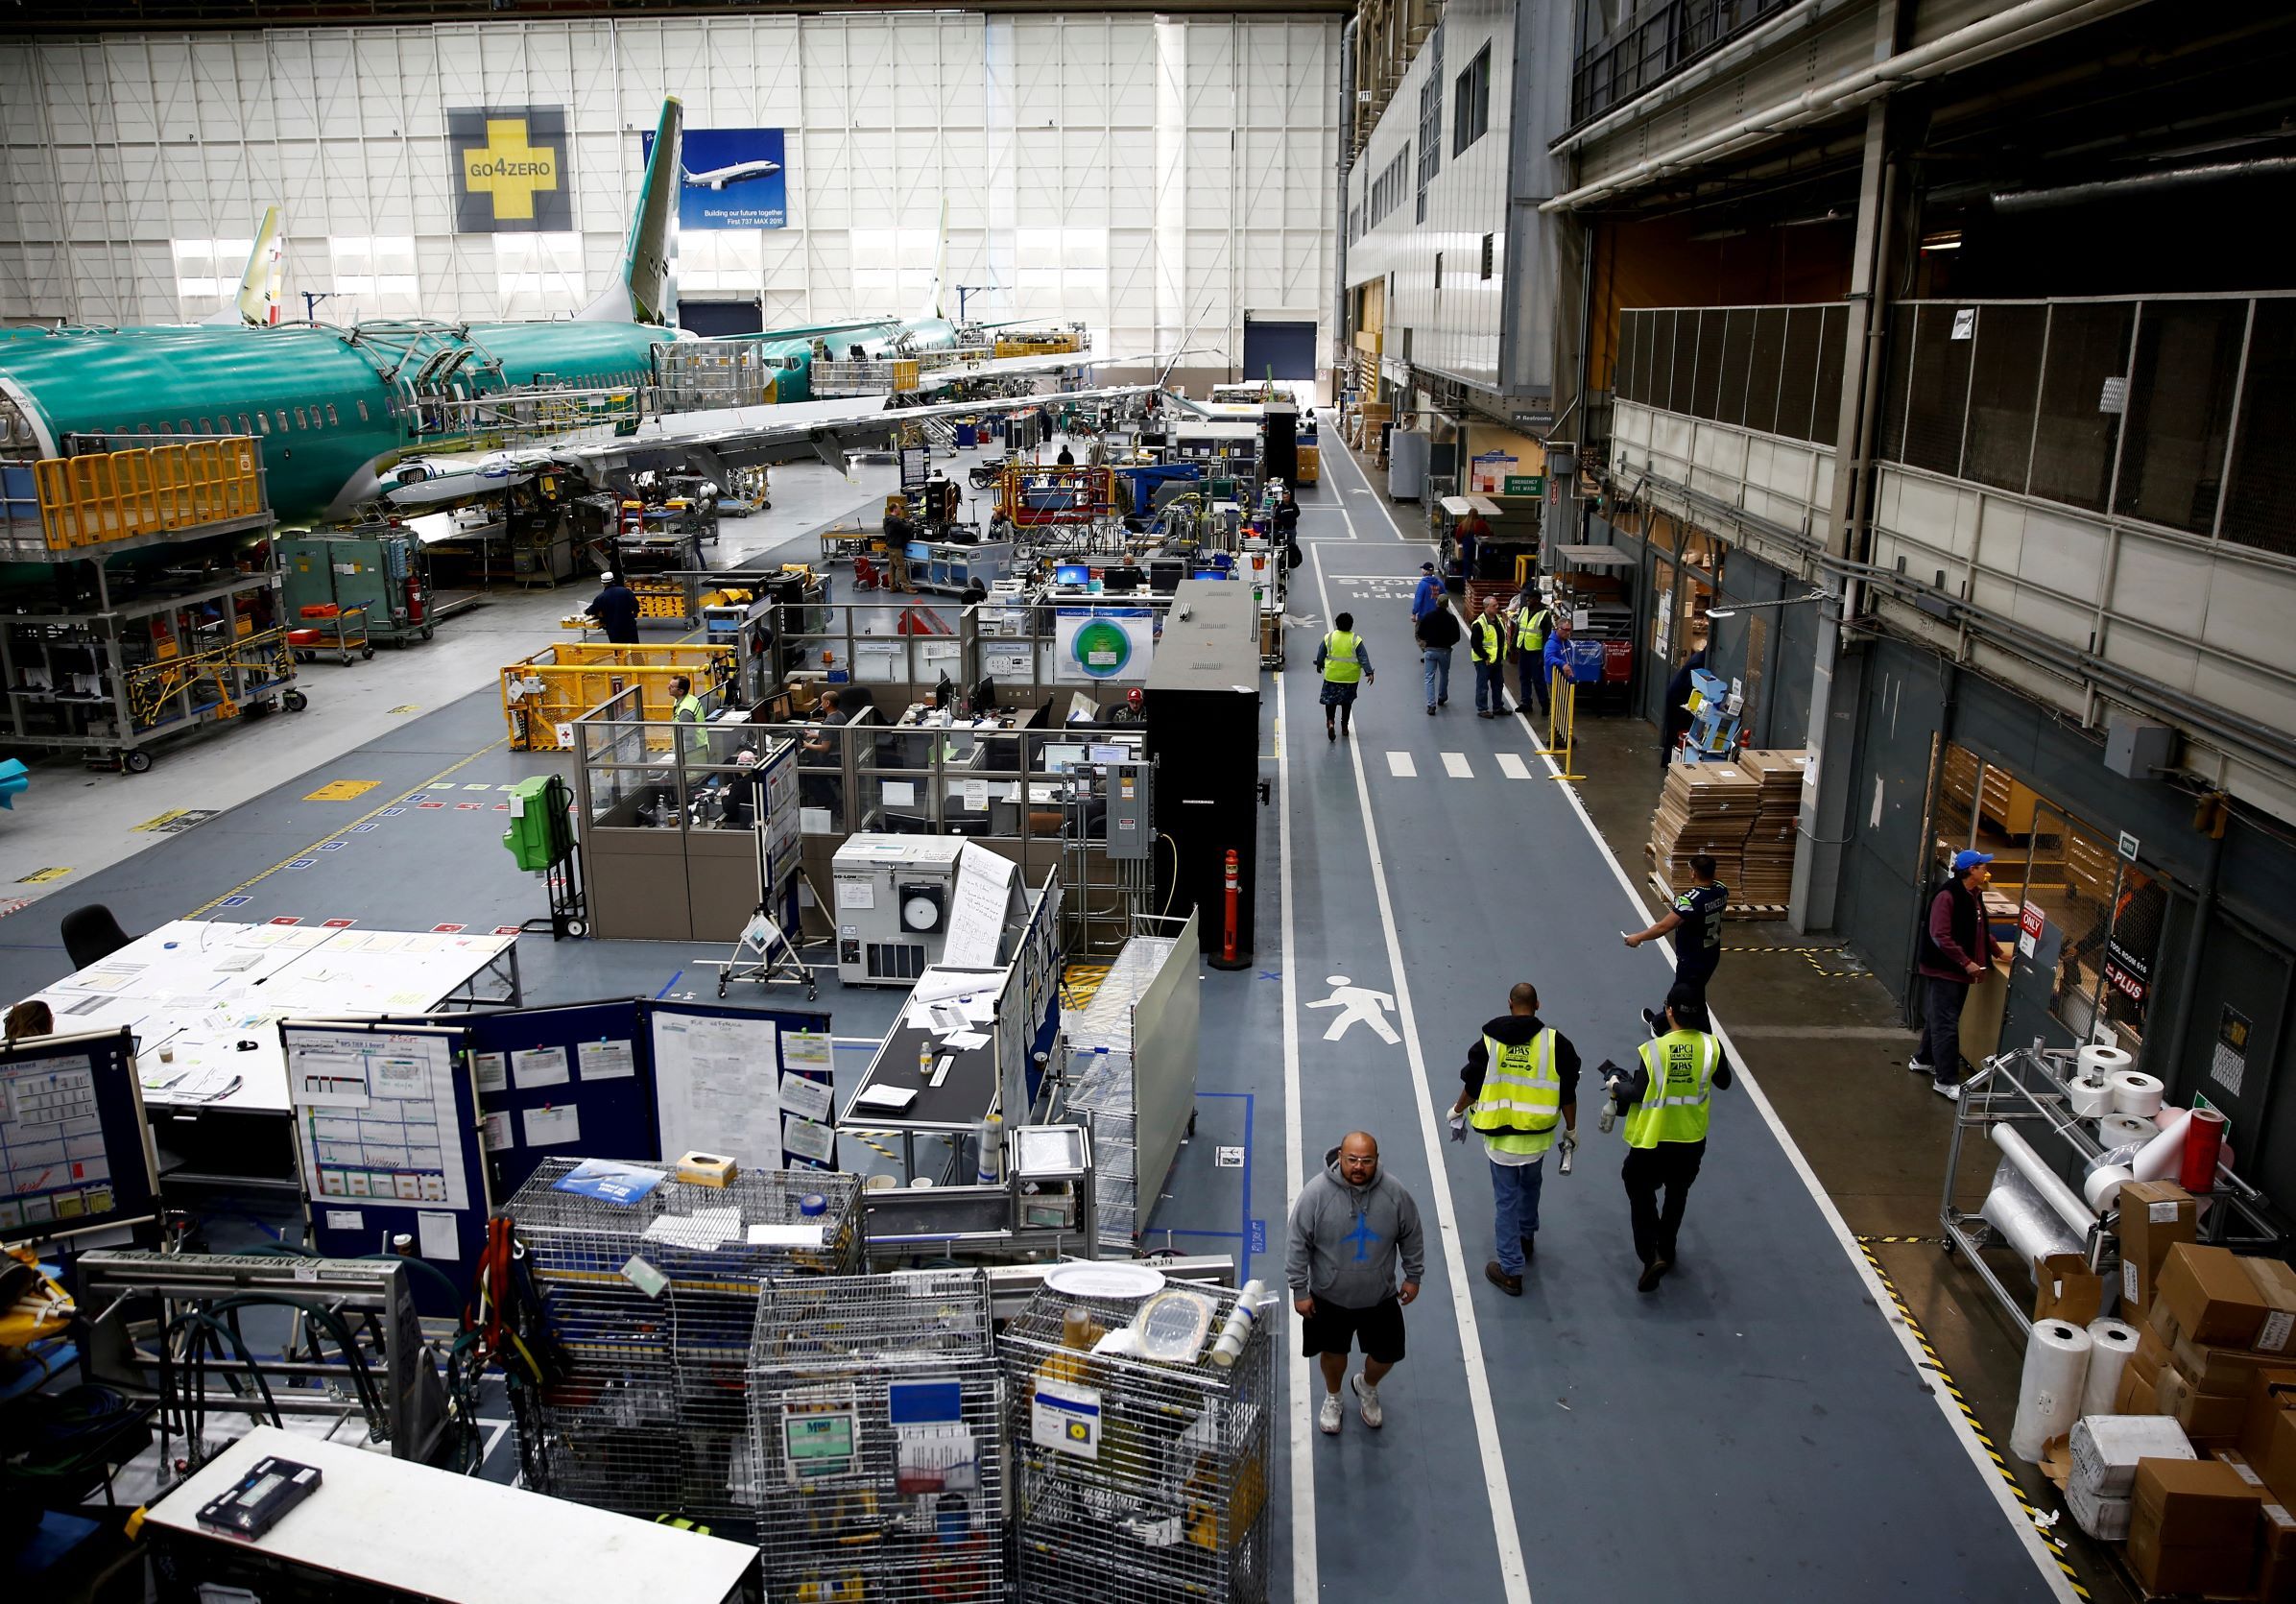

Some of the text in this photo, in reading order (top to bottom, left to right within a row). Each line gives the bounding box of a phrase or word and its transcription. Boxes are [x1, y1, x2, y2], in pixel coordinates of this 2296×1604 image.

[1358, 89, 1372, 102] J11
[470, 157, 550, 178] GO4ZERO
[705, 208, 728, 218] Building
[758, 208, 783, 218] together
[1684, 888, 1700, 900] 31
[2023, 914, 2041, 932] ONLY
[2110, 940, 2147, 973] TOOL ROOM 616
[2114, 970, 2142, 998] PLUS
[1514, 1045, 1530, 1055] PAS
[1678, 1043, 1693, 1053] PCI
[15, 1061, 36, 1070] Board
[1678, 1061, 1693, 1069] PAS
[202, 1253, 323, 1270] TRANSPORTER
